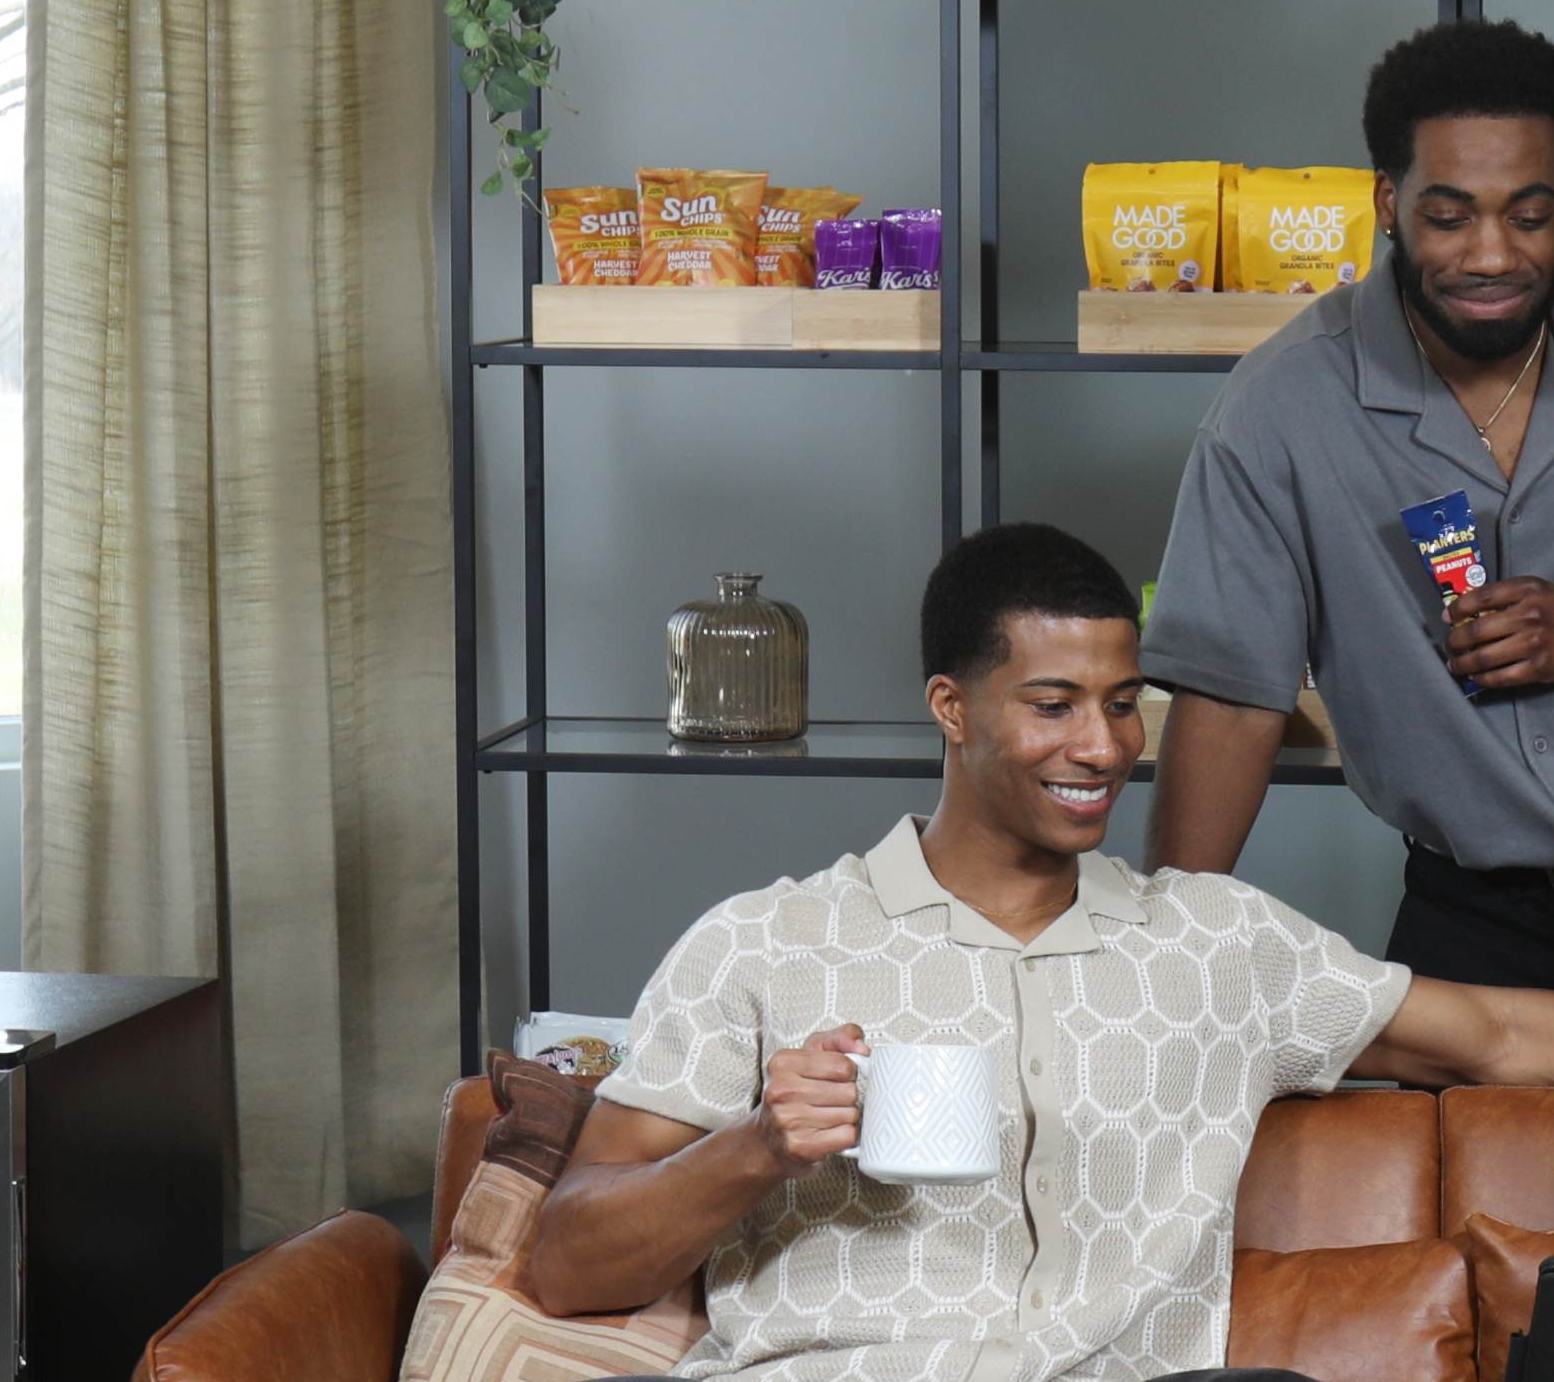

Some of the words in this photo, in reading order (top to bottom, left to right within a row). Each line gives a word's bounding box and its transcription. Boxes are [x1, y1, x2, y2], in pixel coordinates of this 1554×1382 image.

[660, 195, 717, 221] Sun
[680, 212, 723, 227] CHIPS
[1113, 205, 1186, 228] MADE
[1270, 205, 1344, 229] MADE
[580, 210, 638, 235] Sun
[1112, 227, 1186, 250] GOOD
[1270, 228, 1344, 252] GOOD
[593, 258, 638, 269] HARVEST
[667, 250, 712, 261] HARVEST
[1419, 529, 1476, 556] PLANTERS
[1436, 557, 1472, 574] PEANUTS
